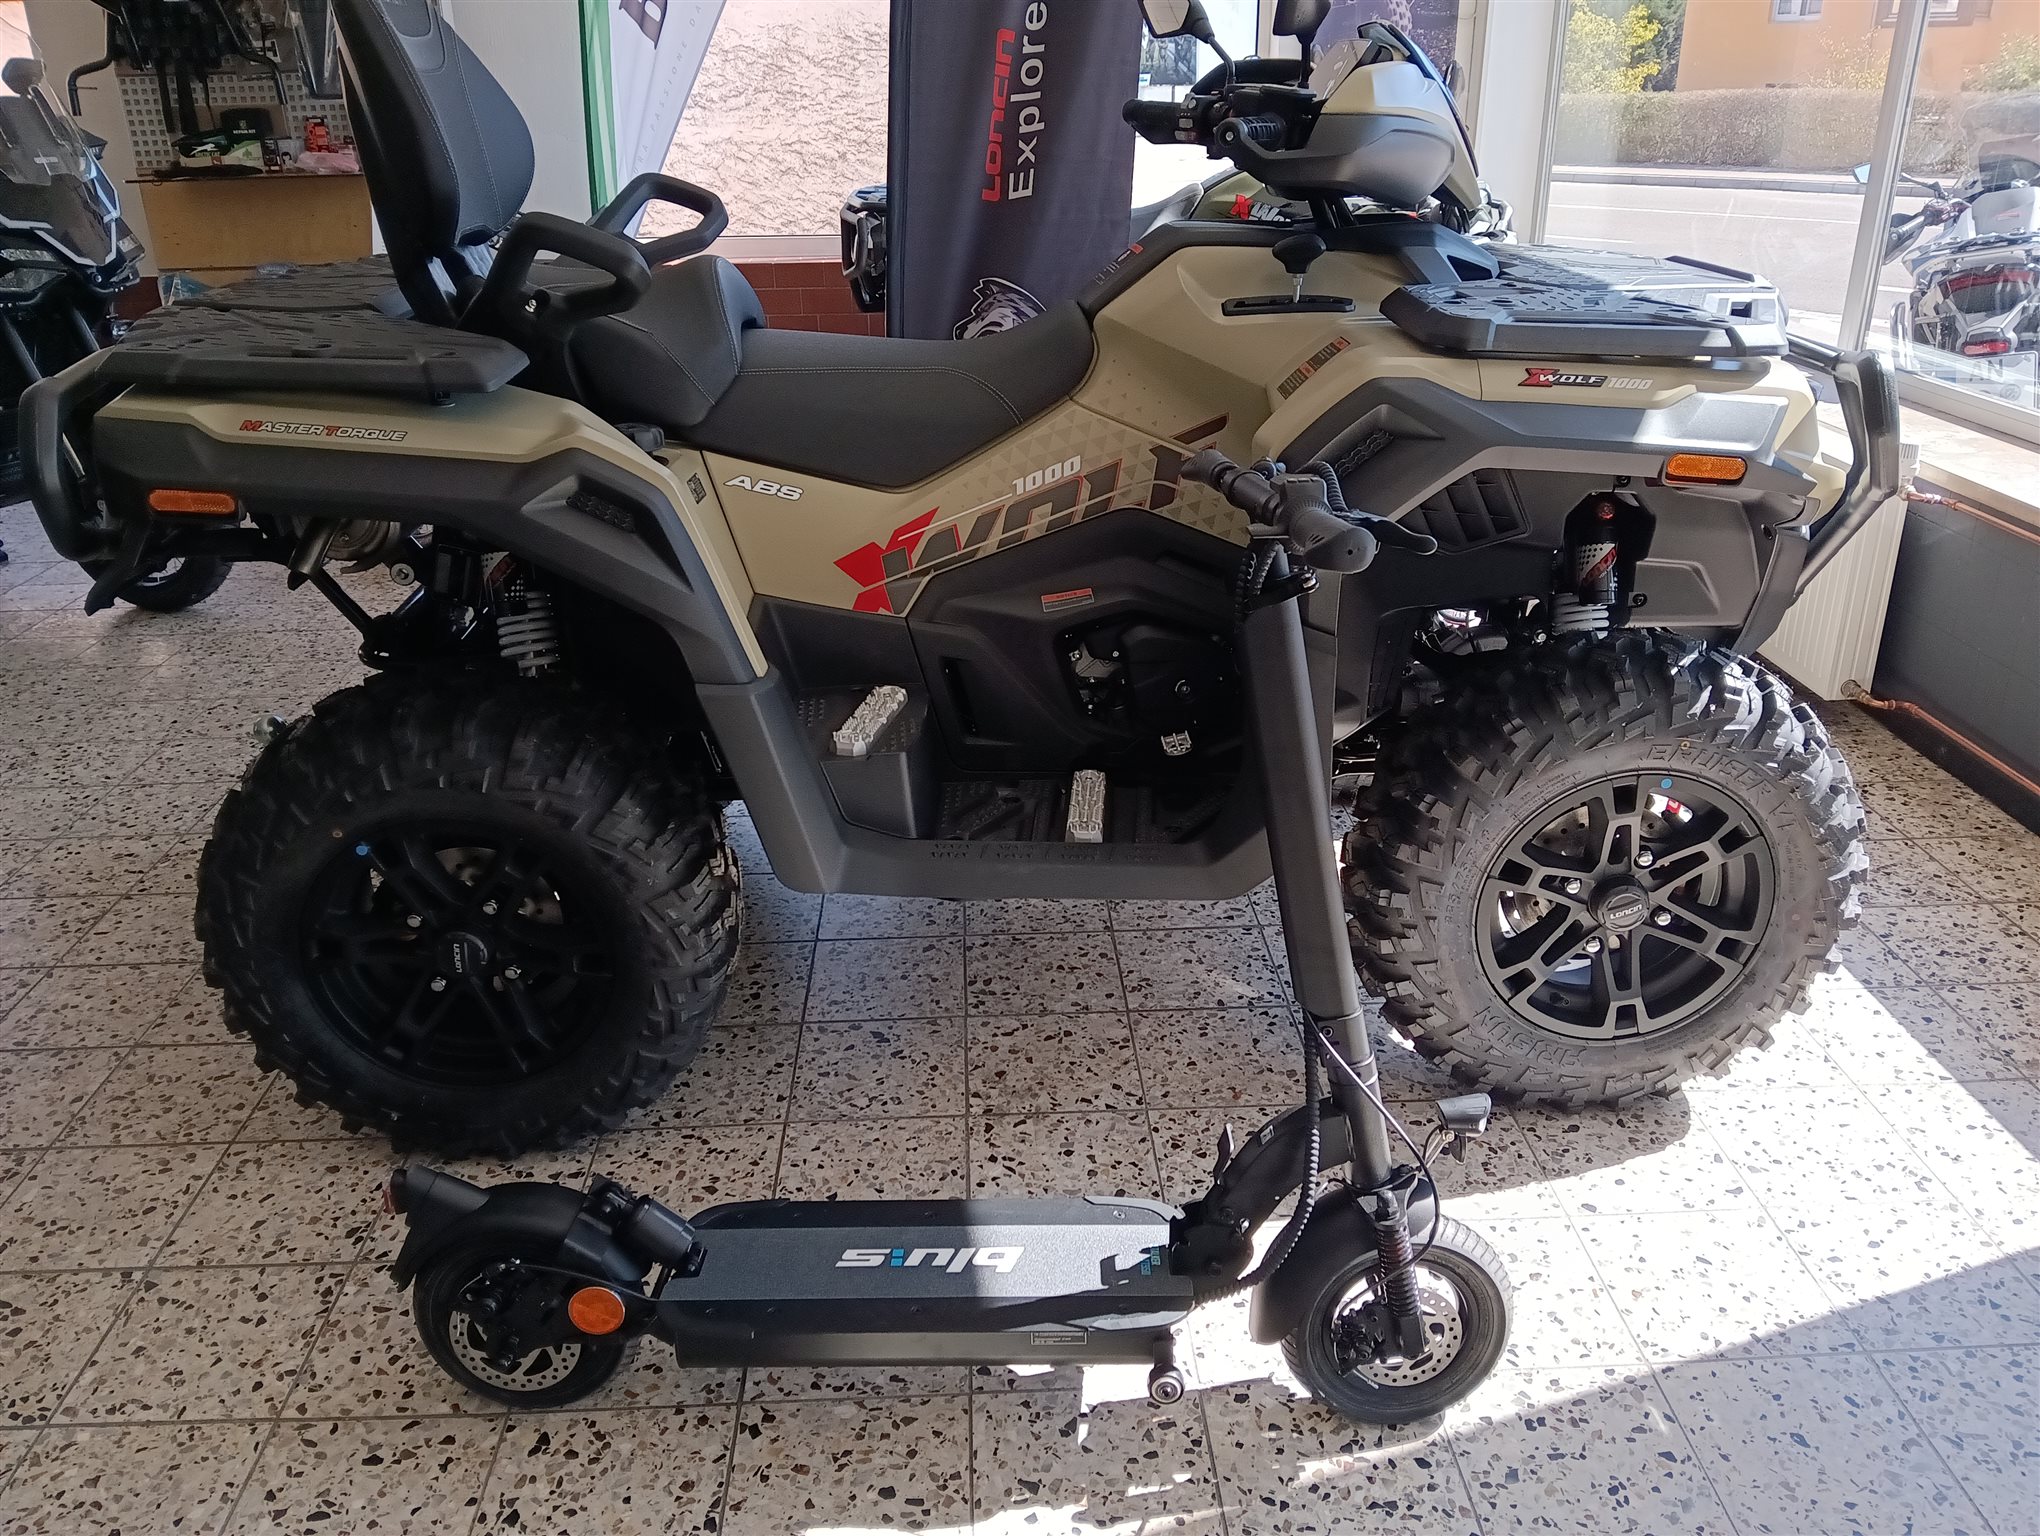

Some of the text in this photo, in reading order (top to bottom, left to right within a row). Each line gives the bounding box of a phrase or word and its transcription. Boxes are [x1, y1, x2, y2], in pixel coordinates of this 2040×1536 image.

[1608, 377, 1654, 389] 1000
[239, 420, 408, 441] MASTER TORQUE
[1012, 455, 1082, 496] 1000
[723, 475, 804, 501] ABS
[1610, 904, 1643, 919] LONCIN
[453, 943, 463, 973] LONCIN
